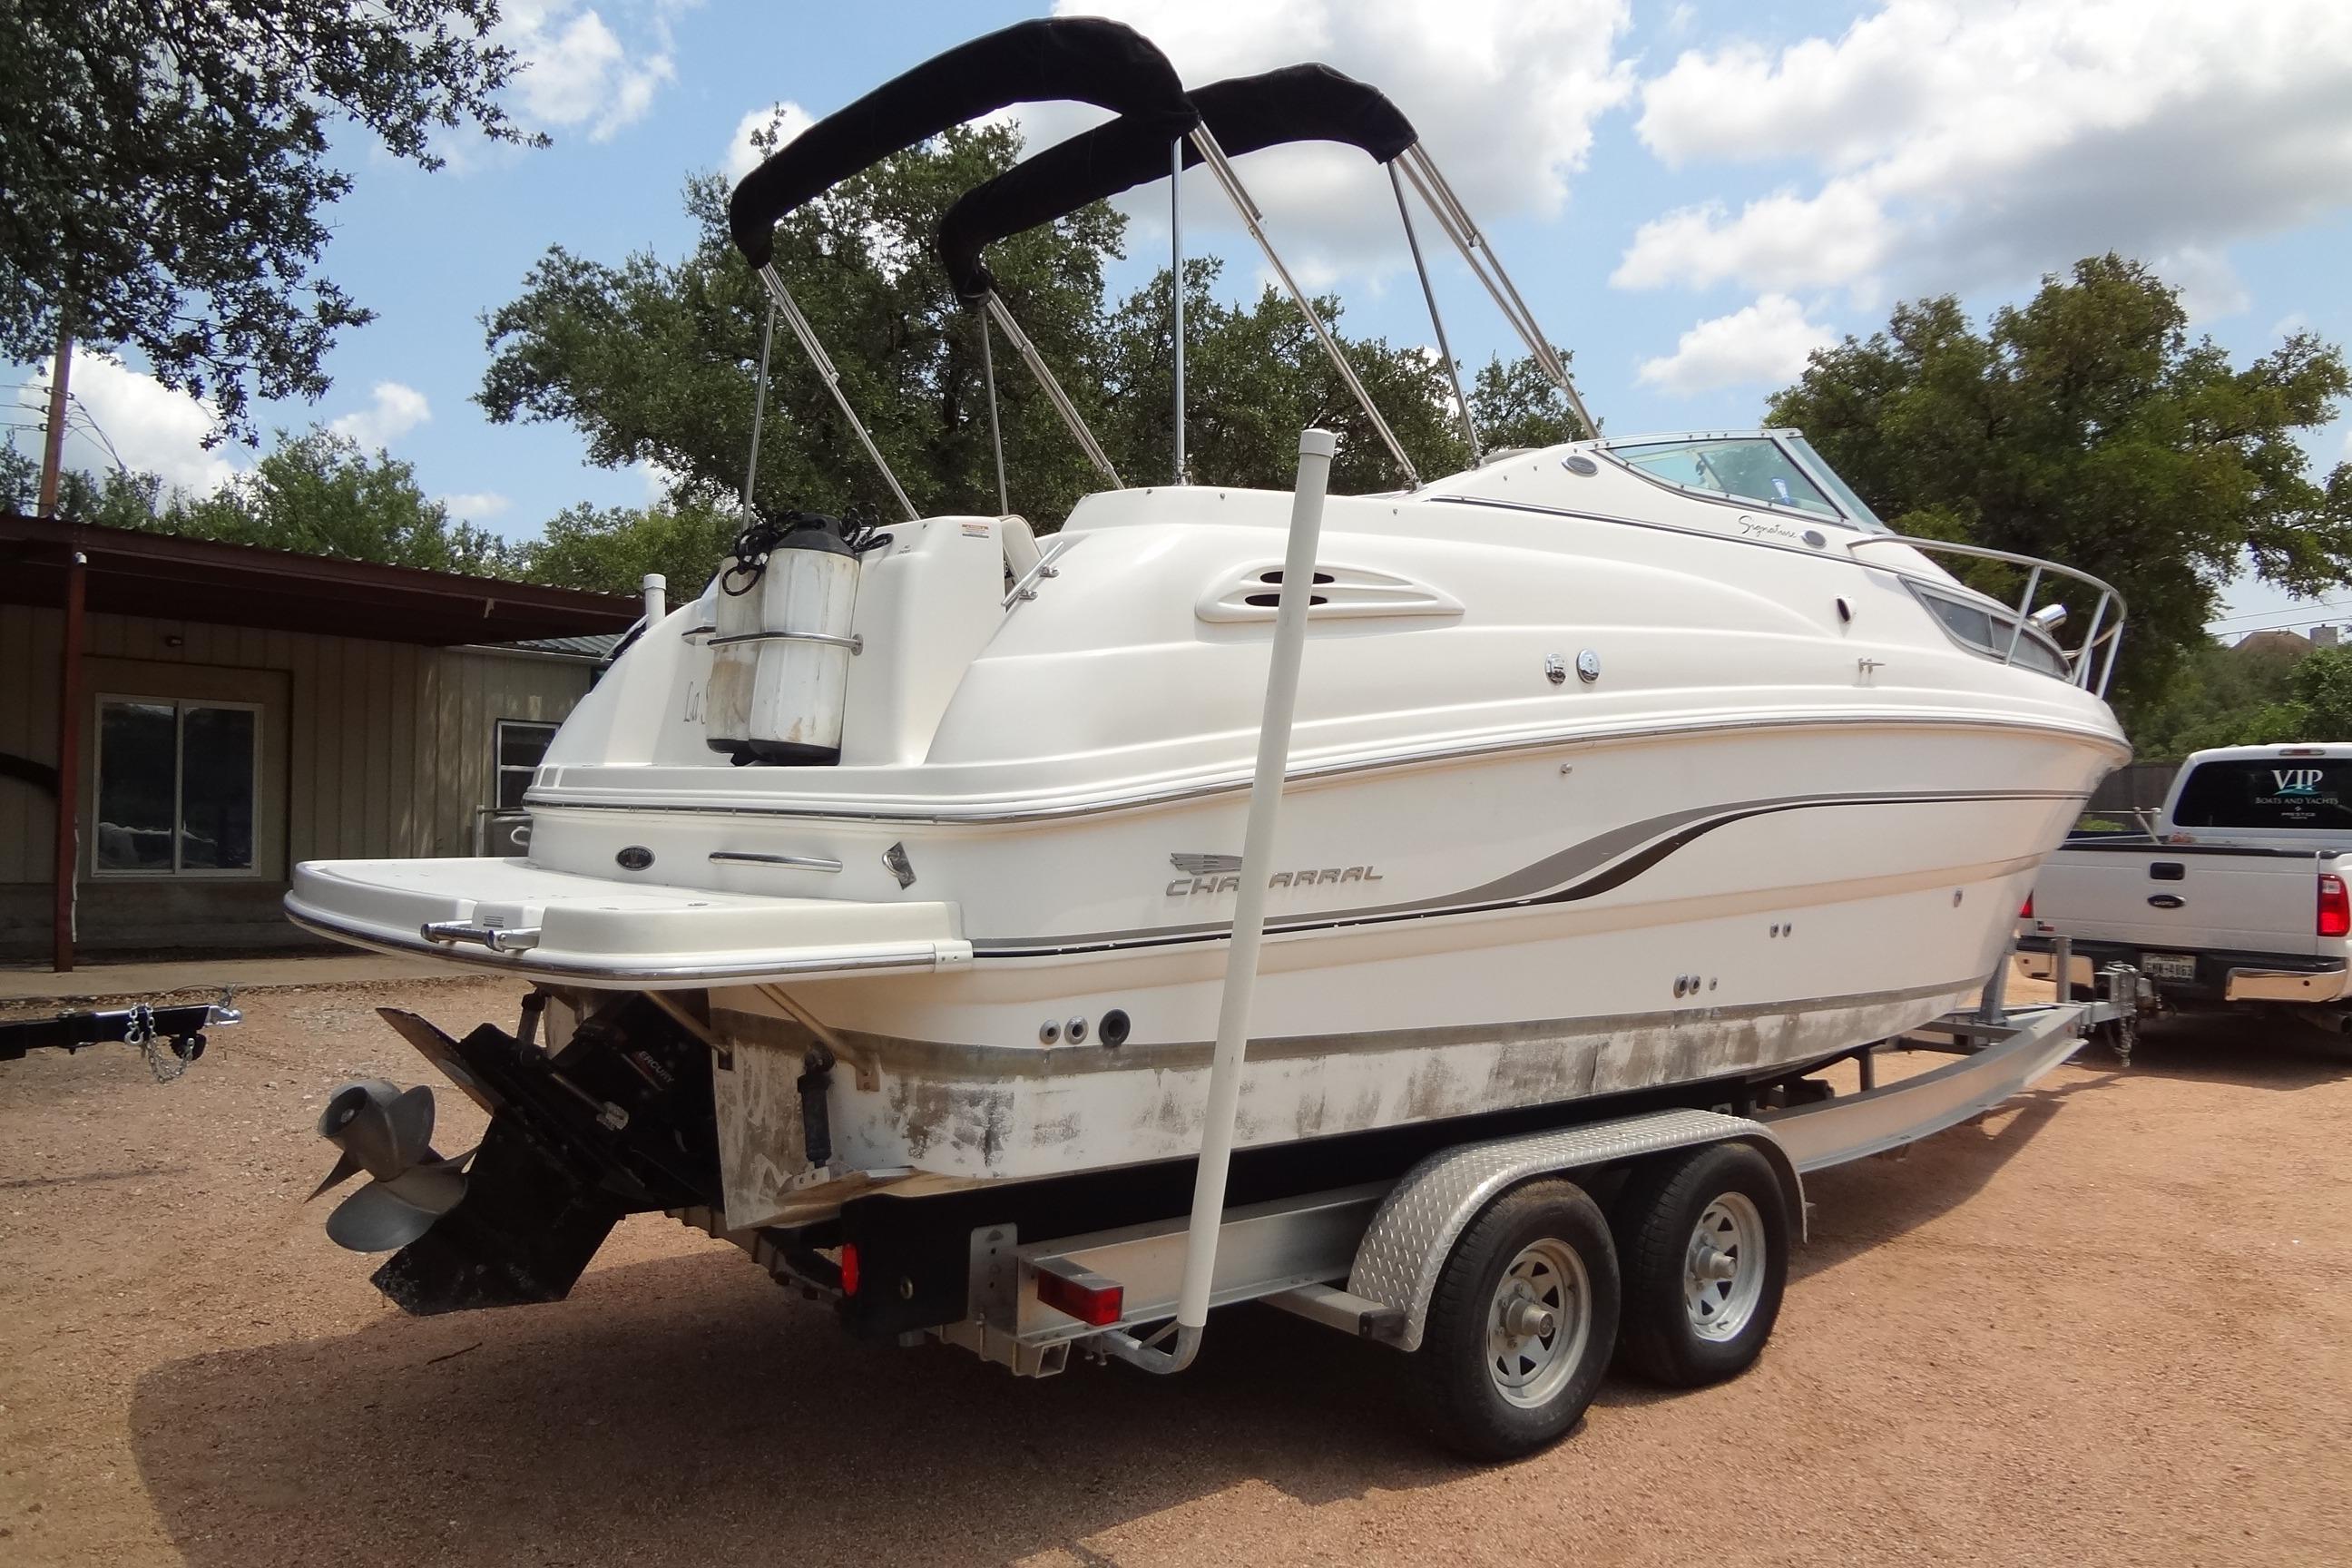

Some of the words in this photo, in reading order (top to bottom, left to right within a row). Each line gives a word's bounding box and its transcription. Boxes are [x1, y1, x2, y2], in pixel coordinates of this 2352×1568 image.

[1737, 514, 1798, 538] Signature
[2270, 769, 2324, 791] VIP
[2284, 797, 2304, 805] AND
[1166, 866, 1384, 897] CHAARRAL
[635, 1050, 675, 1083] ERCURY
